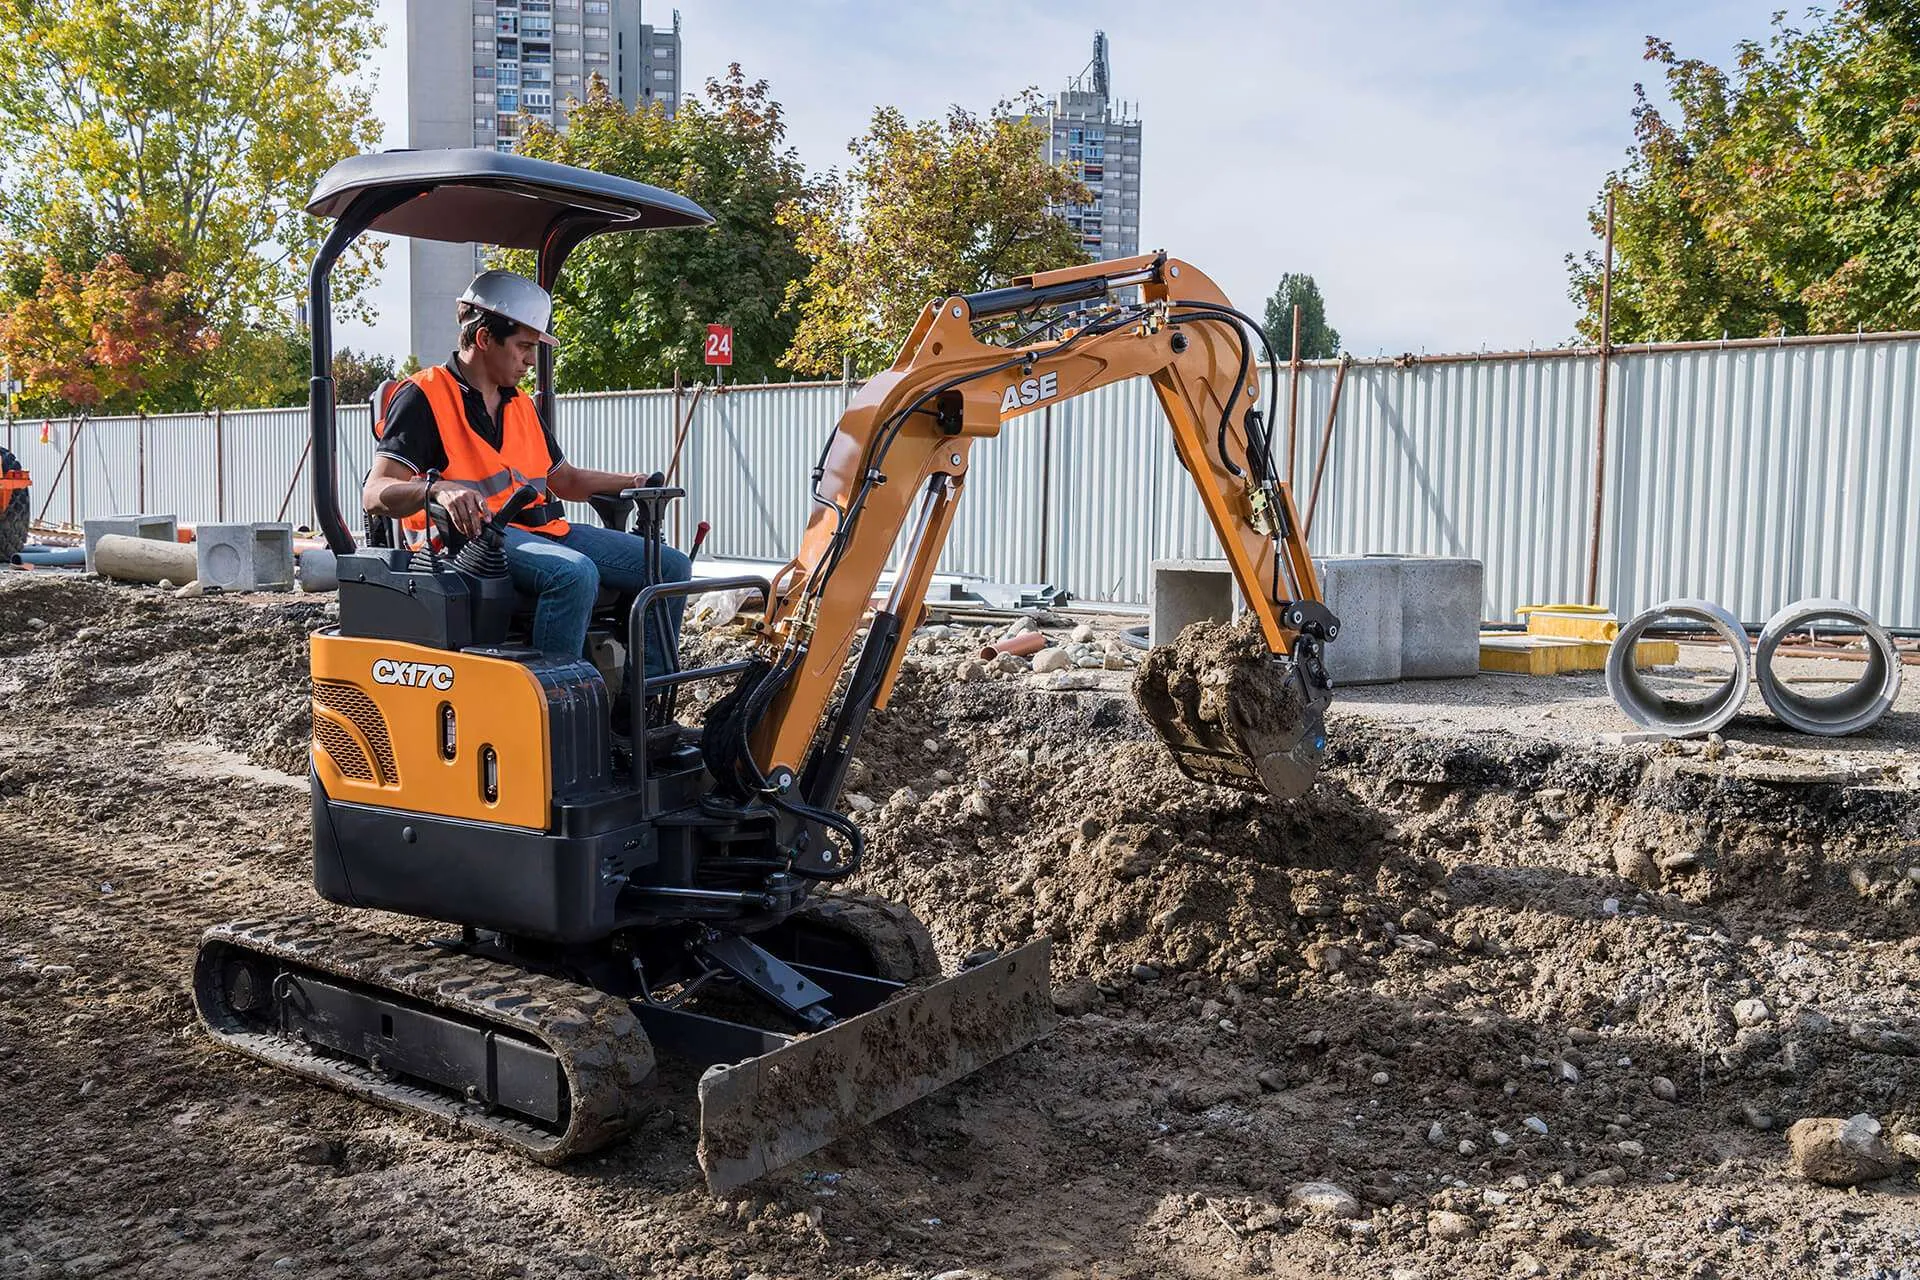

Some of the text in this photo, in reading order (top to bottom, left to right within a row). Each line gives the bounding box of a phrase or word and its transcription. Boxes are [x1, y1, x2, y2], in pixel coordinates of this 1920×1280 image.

[708, 334, 730, 356] 24
[999, 371, 1057, 414] ASE
[372, 659, 454, 691] CX17C
